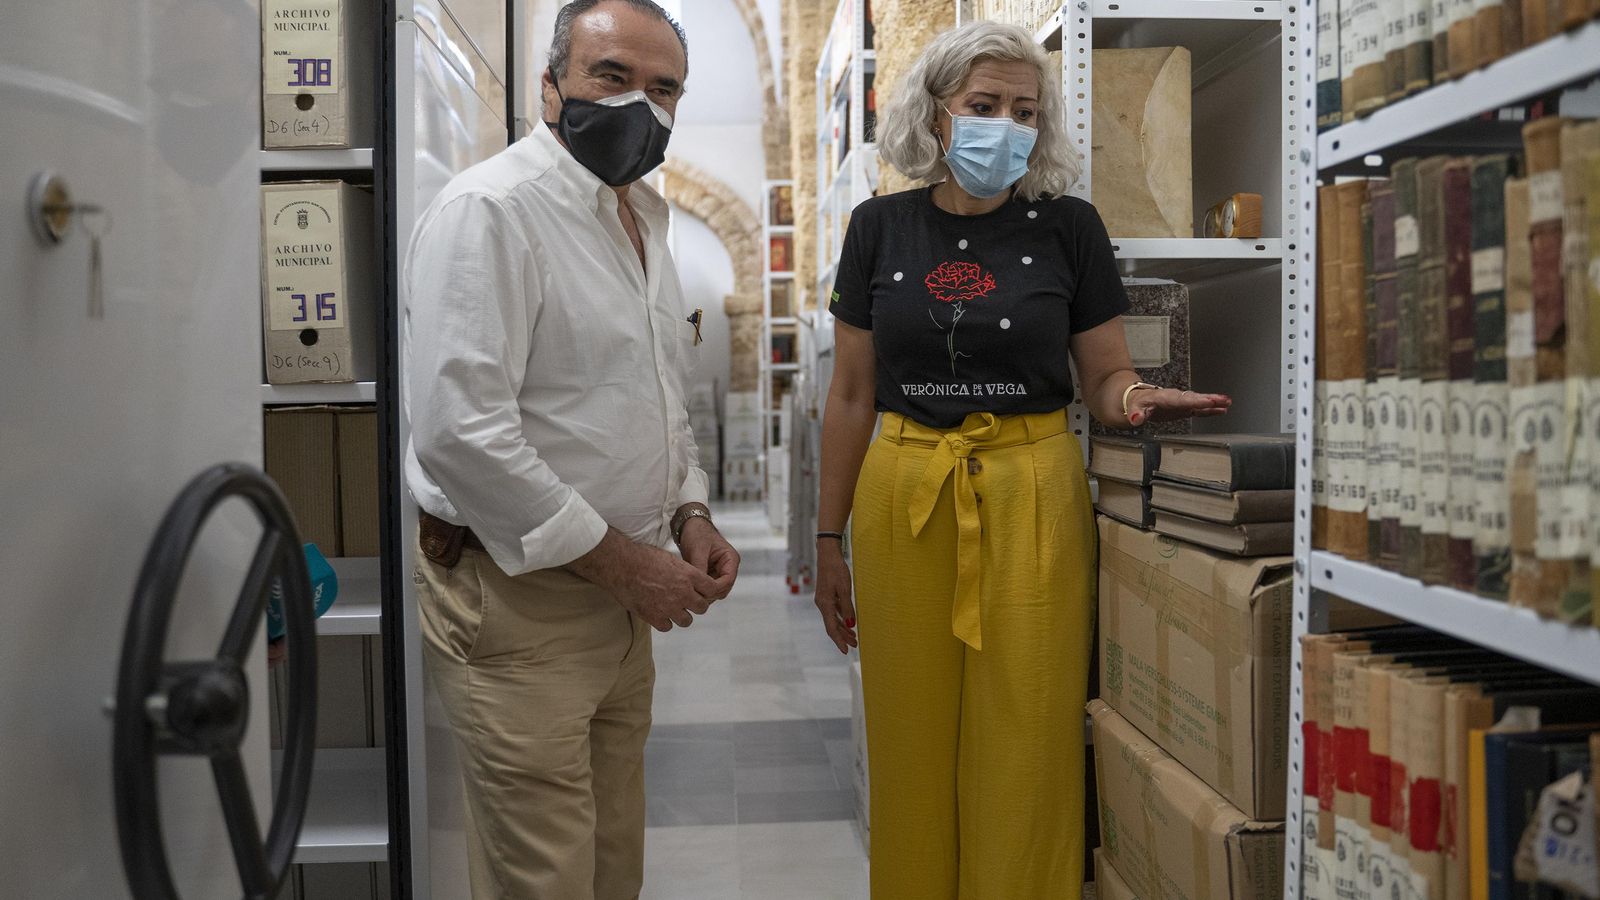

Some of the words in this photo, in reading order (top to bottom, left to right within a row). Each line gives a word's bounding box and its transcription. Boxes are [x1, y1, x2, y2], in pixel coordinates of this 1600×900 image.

[273, 9, 331, 19] ARCHIVO
[273, 22, 331, 32] MUNICIPAL
[287, 58, 332, 87] 308
[275, 243, 332, 255] ARCHIVO
[275, 256, 334, 268] MUNICIPAL
[985, 382, 1028, 395] VEGA
